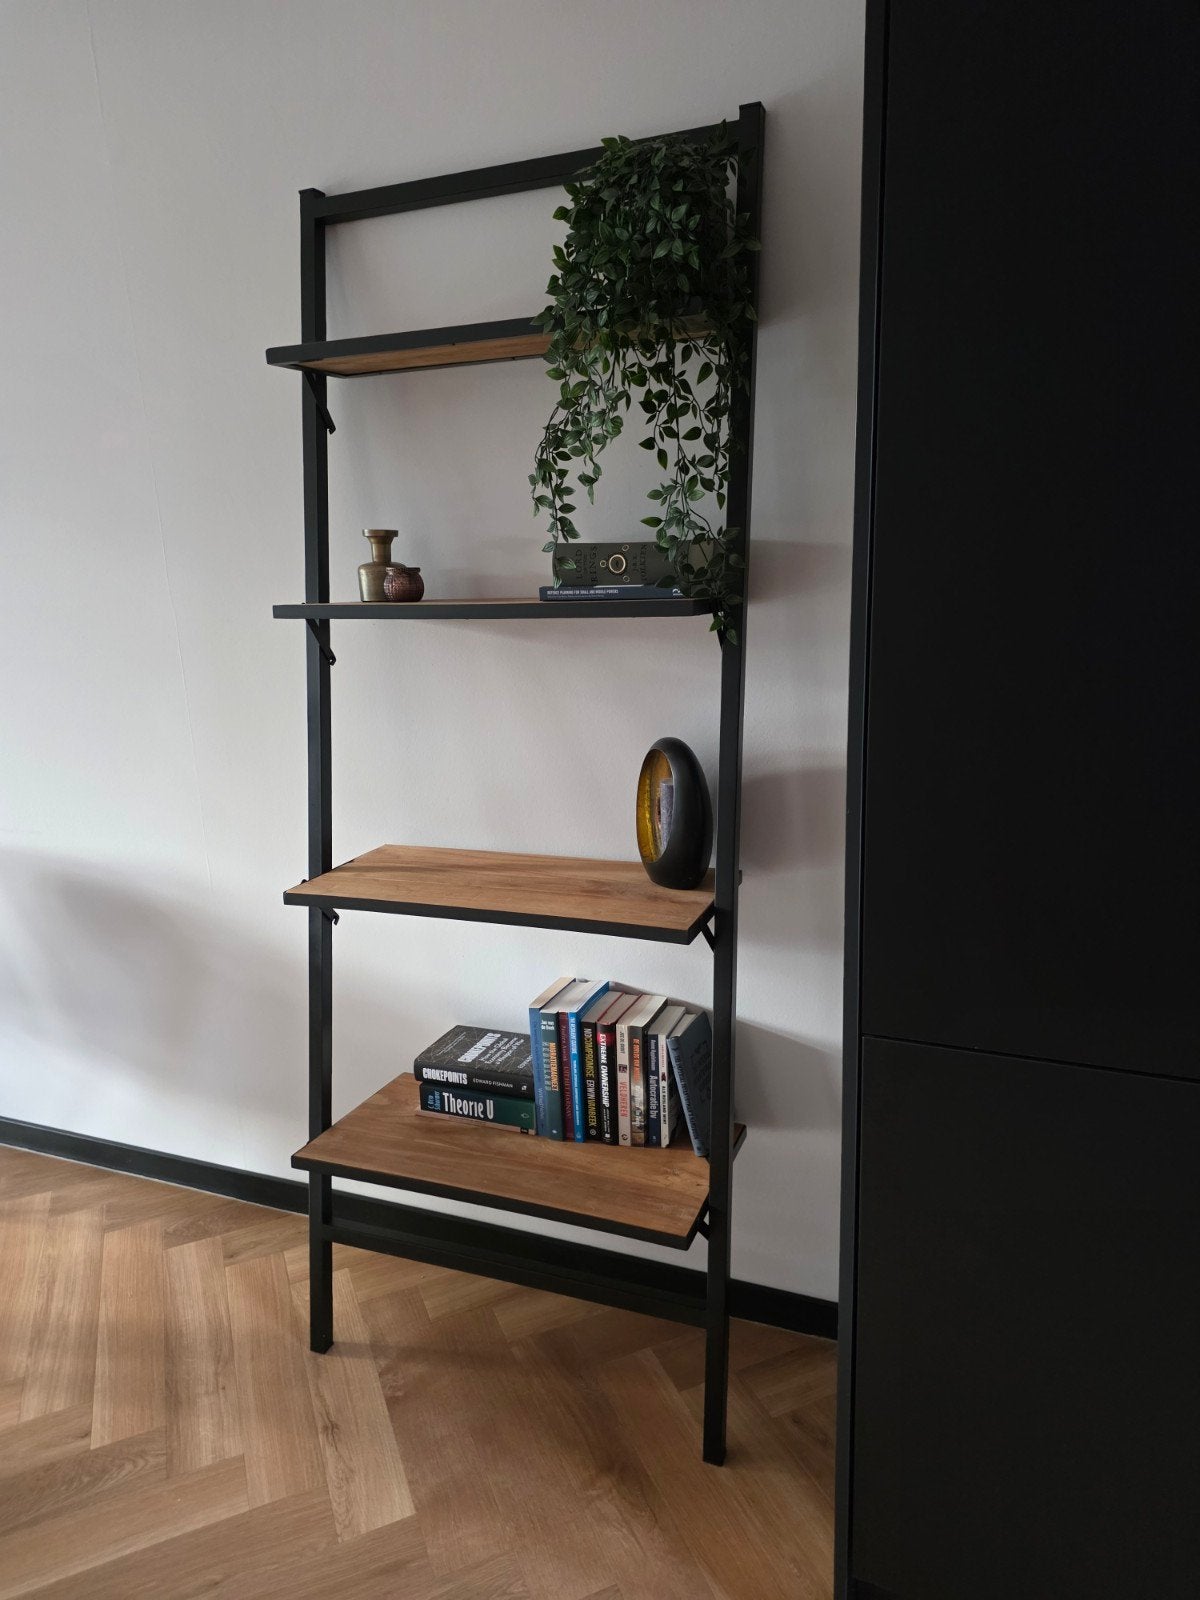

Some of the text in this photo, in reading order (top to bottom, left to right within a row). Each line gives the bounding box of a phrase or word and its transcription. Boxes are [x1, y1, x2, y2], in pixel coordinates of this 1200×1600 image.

[589, 546, 598, 582] RINGS
[422, 1068, 468, 1085] CHOKEPOINTS
[542, 1042, 551, 1091] NEDERLAND
[586, 1080, 595, 1099] ERWIN
[601, 1065, 609, 1108] OWNERSHIP
[619, 1082, 628, 1118] VELDHEREN
[649, 1075, 658, 1110] Autocratie
[442, 1092, 494, 1119] Theorie U
[650, 1111, 658, 1119] bv
